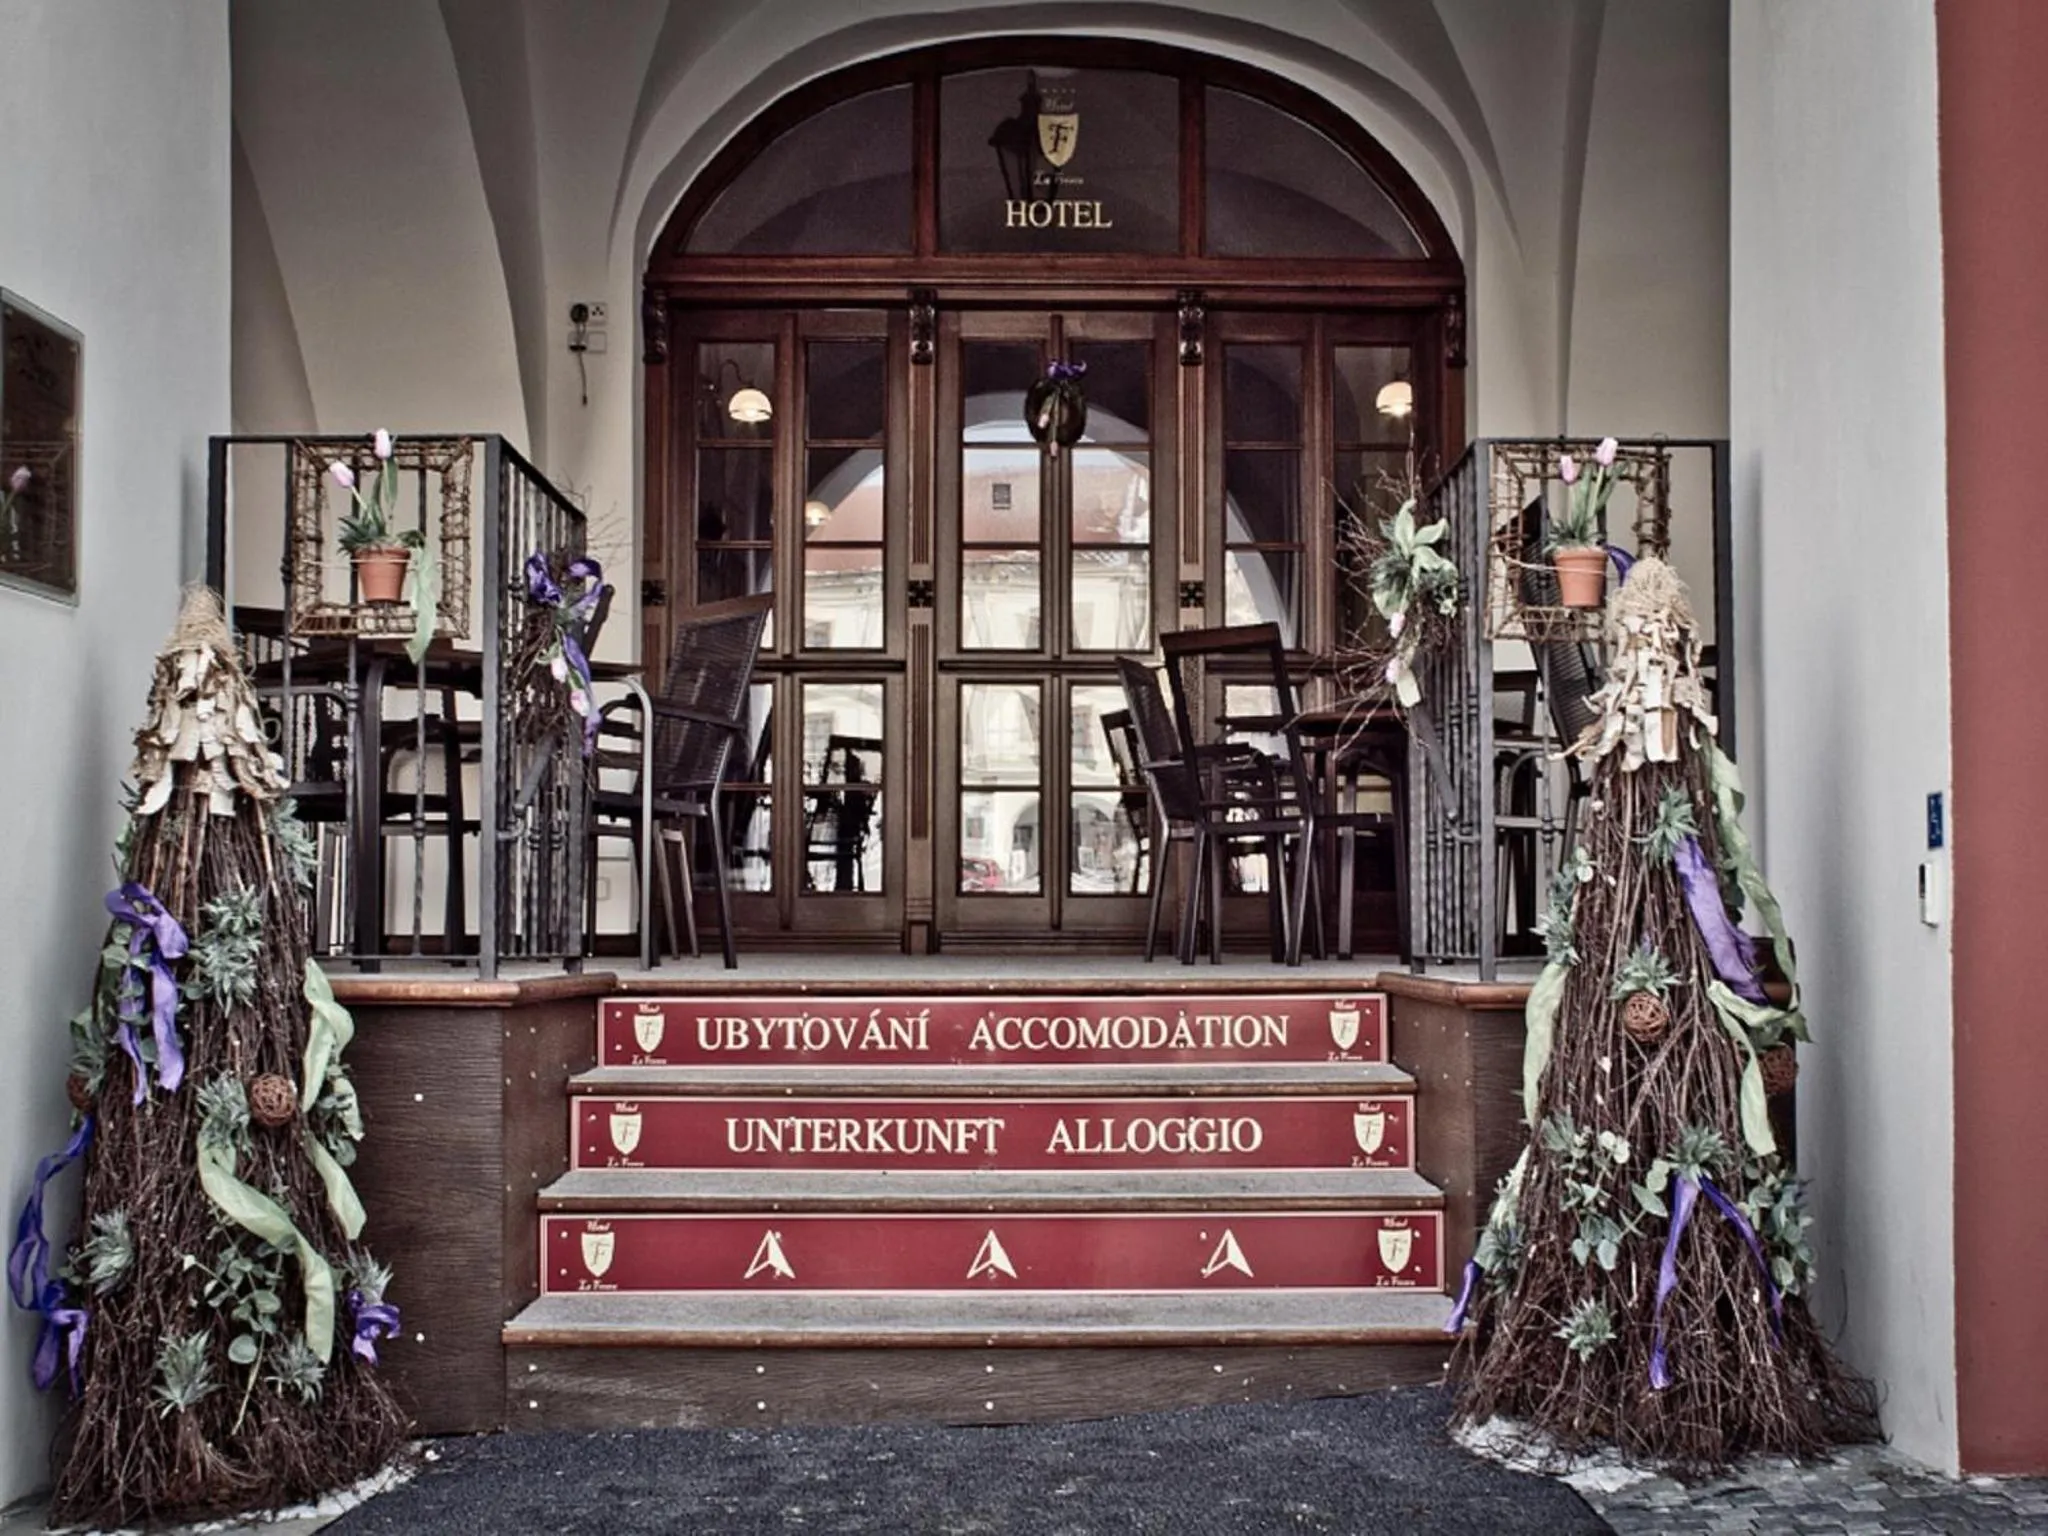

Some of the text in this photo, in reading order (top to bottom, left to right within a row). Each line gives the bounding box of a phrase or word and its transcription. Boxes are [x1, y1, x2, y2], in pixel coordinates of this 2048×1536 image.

[1006, 199, 1113, 228] HOTEL
[696, 1008, 1290, 1051] UBYTOVÁNÍ ACCOMODATION
[724, 1117, 1263, 1154] UNTERKUNFT ALLOGGIO
